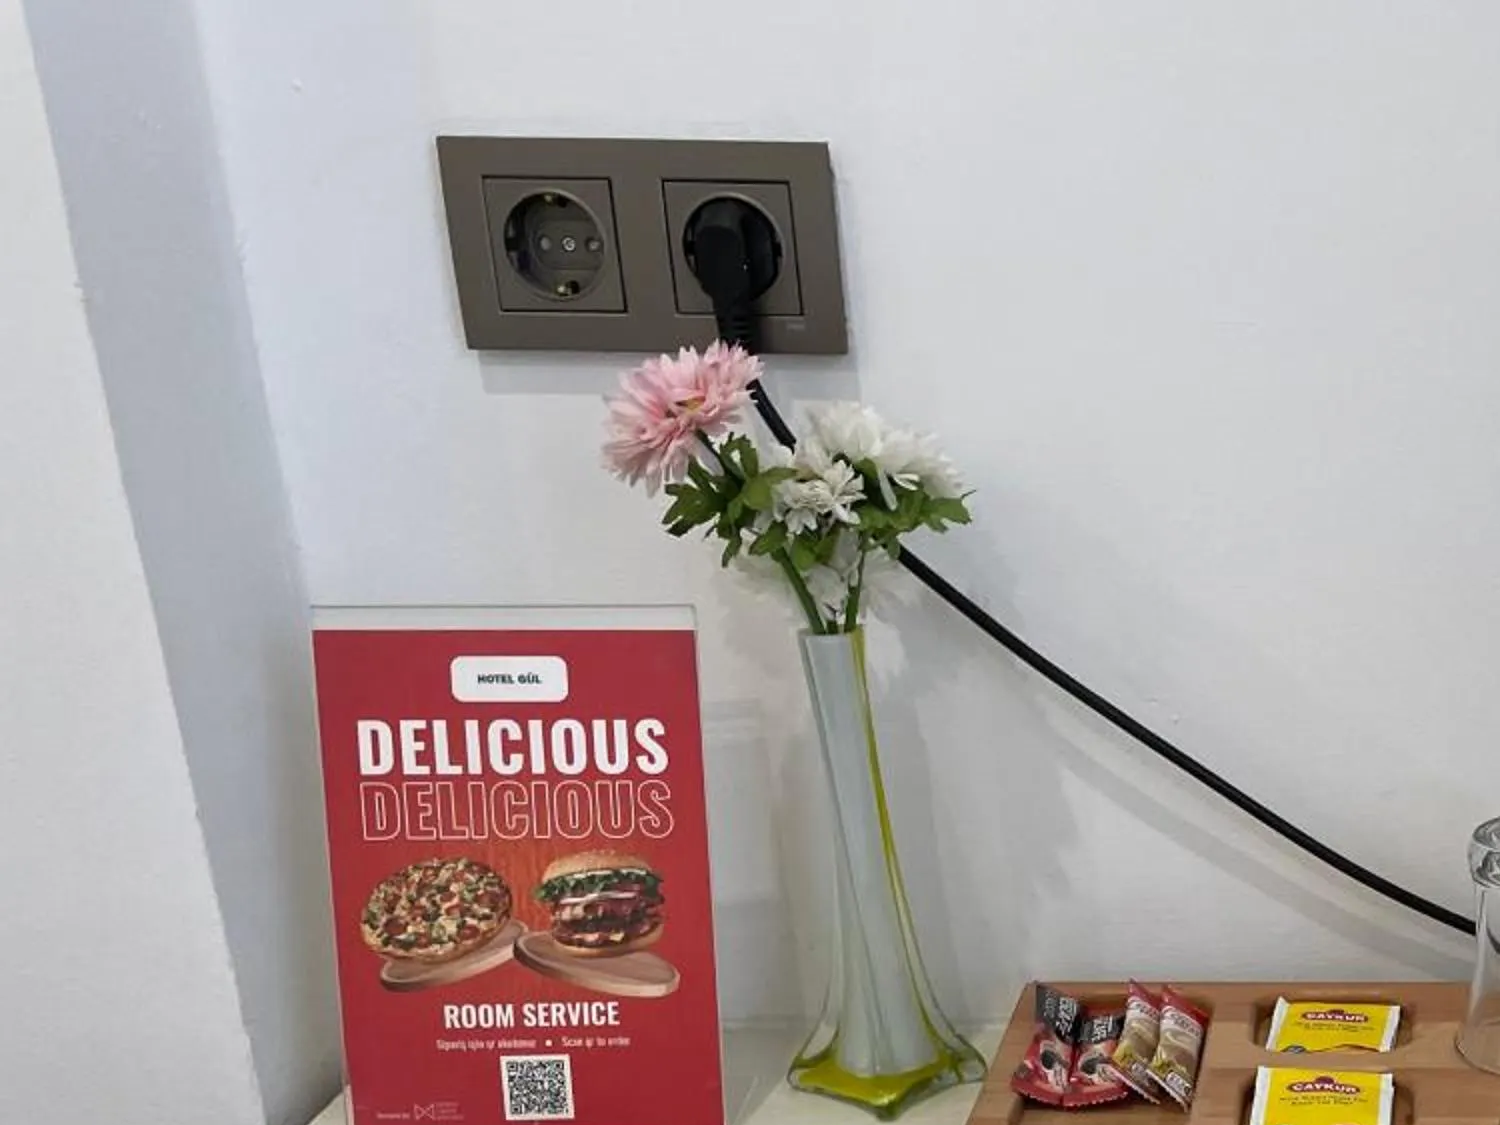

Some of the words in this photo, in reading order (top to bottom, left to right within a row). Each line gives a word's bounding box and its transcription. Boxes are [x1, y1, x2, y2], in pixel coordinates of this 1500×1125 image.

[477, 673, 515, 685] HOTEL
[517, 671, 543, 685] GÜL
[357, 718, 669, 775] DELICIOUS
[359, 780, 675, 840] DELICIOUS
[444, 1004, 515, 1029] ROOM
[522, 1001, 621, 1027] SERVICE
